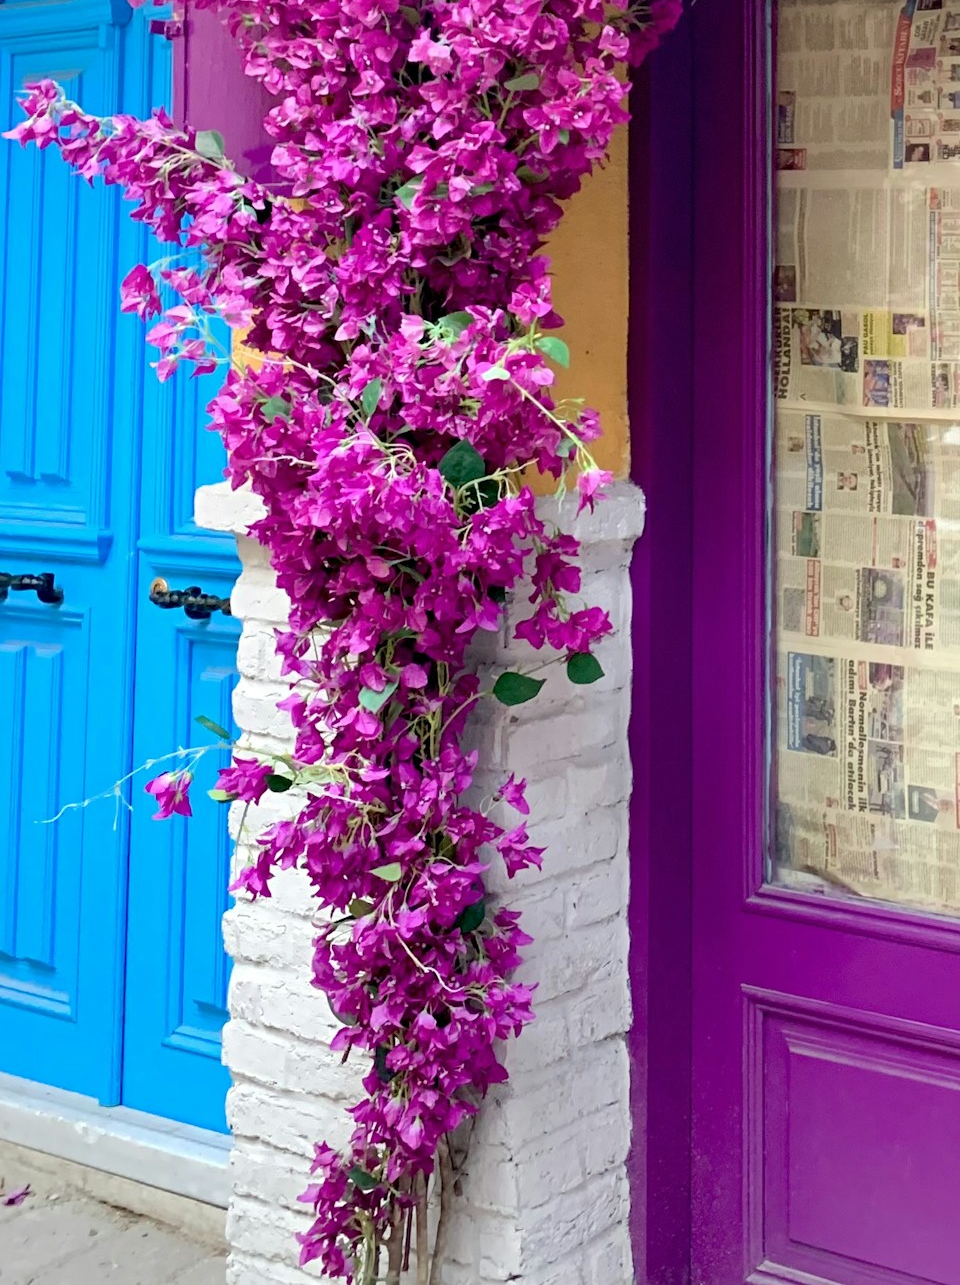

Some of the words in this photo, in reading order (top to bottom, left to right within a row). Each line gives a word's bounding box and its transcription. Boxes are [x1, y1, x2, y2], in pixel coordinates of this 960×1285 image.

[777, 308, 791, 400] HOLLANDA!
[915, 521, 926, 582] depremden
[913, 583, 924, 602] sağ
[926, 571, 935, 590] BU
[914, 605, 924, 649] çıkılmaz
[925, 593, 934, 628] KAFA
[925, 632, 935, 650] İLE
[847, 659, 857, 694] adımı
[847, 698, 857, 758] Bartın'da
[855, 691, 868, 793] Normalleşmenin
[847, 761, 857, 811] atılacak
[858, 797, 868, 813] ilk
